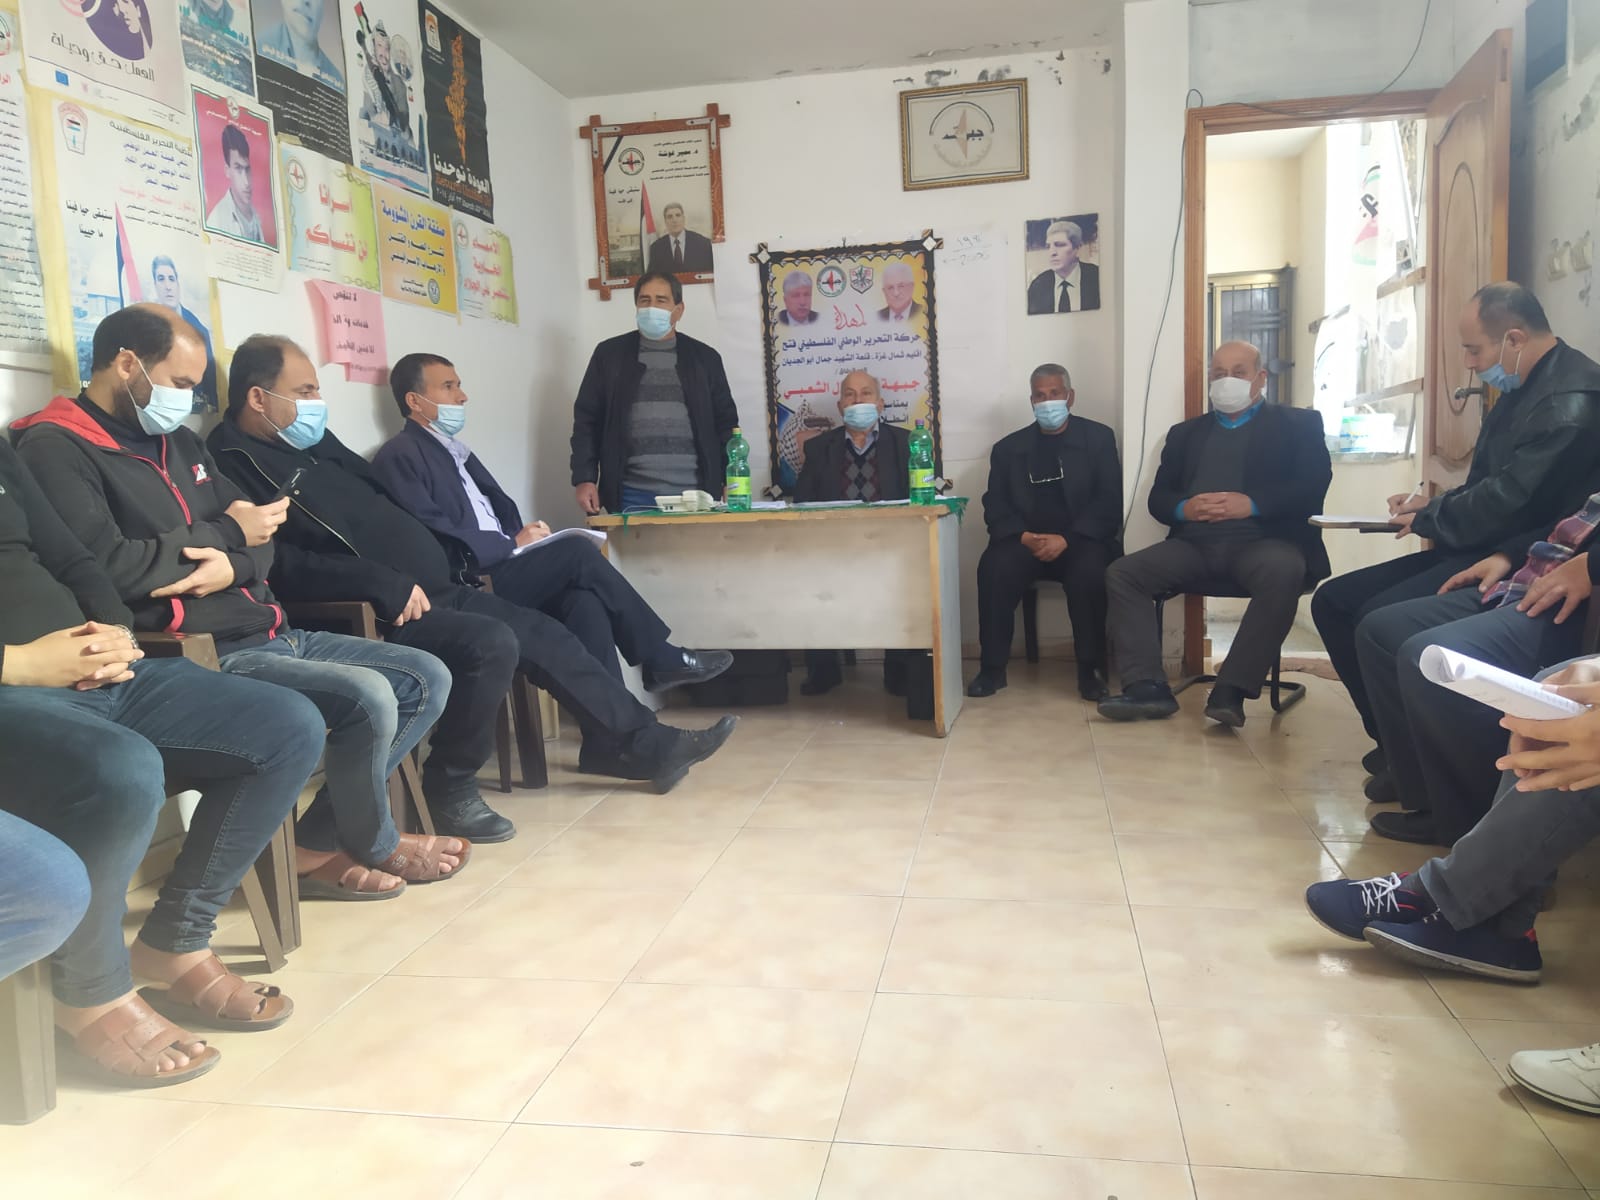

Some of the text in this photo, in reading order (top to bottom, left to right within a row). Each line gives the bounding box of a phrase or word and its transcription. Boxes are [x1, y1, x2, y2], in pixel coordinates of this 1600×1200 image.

[51, 32, 90, 62] وحياة
[124, 61, 155, 82] العمل
[433, 152, 466, 184] توحدنا
[782, 332, 921, 352] حركة التحرير الوطني الفلسطيني فتح
[815, 355, 832, 365] جمال
[833, 353, 855, 363] الشهيد
[888, 351, 905, 361] شمال
[784, 380, 830, 399] الشعبي
[881, 378, 920, 393] جبهة
[884, 400, 909, 411] بمناس
